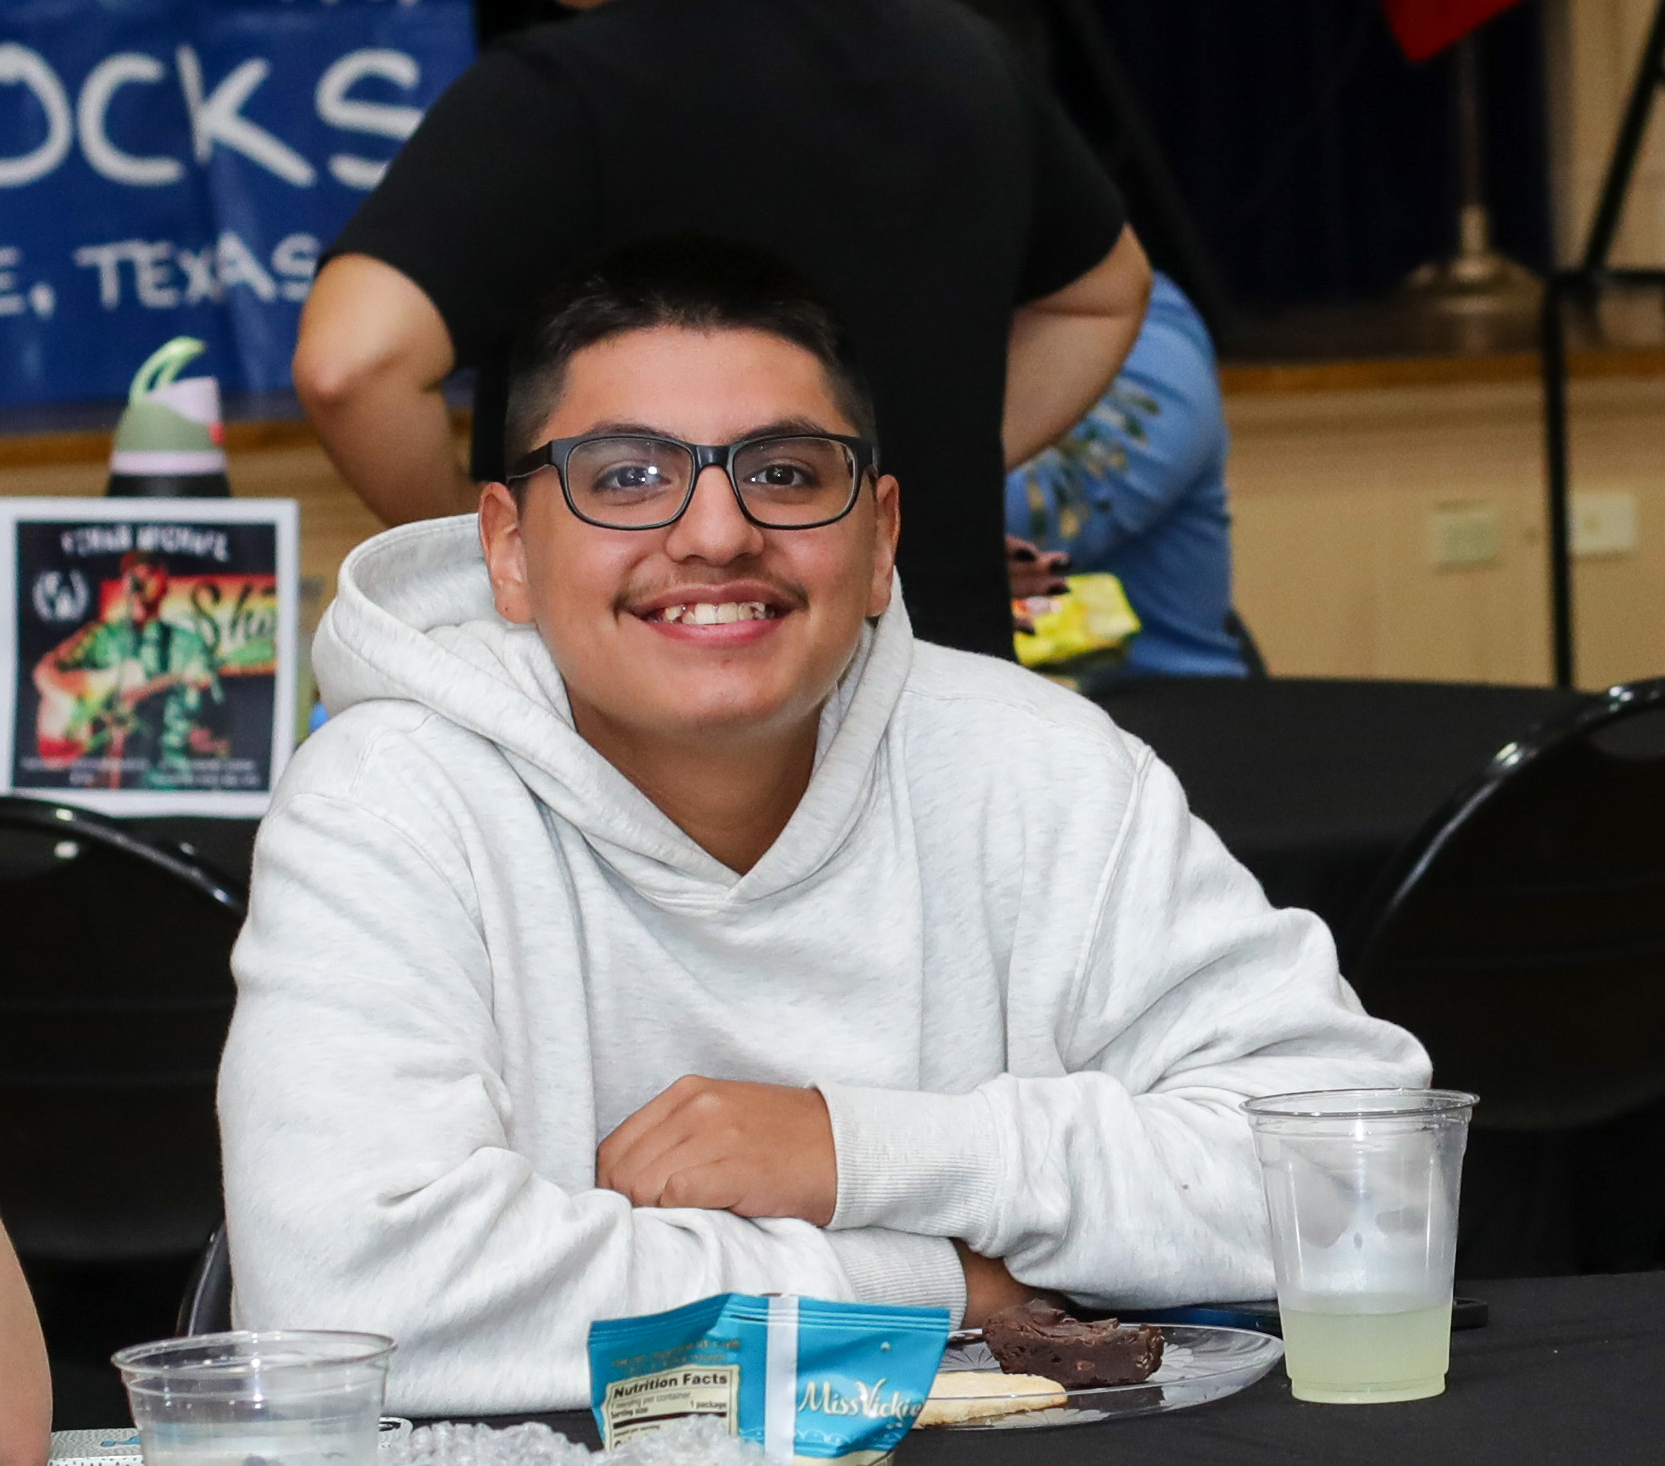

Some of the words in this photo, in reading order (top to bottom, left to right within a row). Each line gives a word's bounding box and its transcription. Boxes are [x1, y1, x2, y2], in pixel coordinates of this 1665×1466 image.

[73, 231, 320, 312] TEXAS
[613, 1376, 678, 1399] Nutrition
[682, 1373, 728, 1385] Facts
[798, 1380, 859, 1416] Miss
